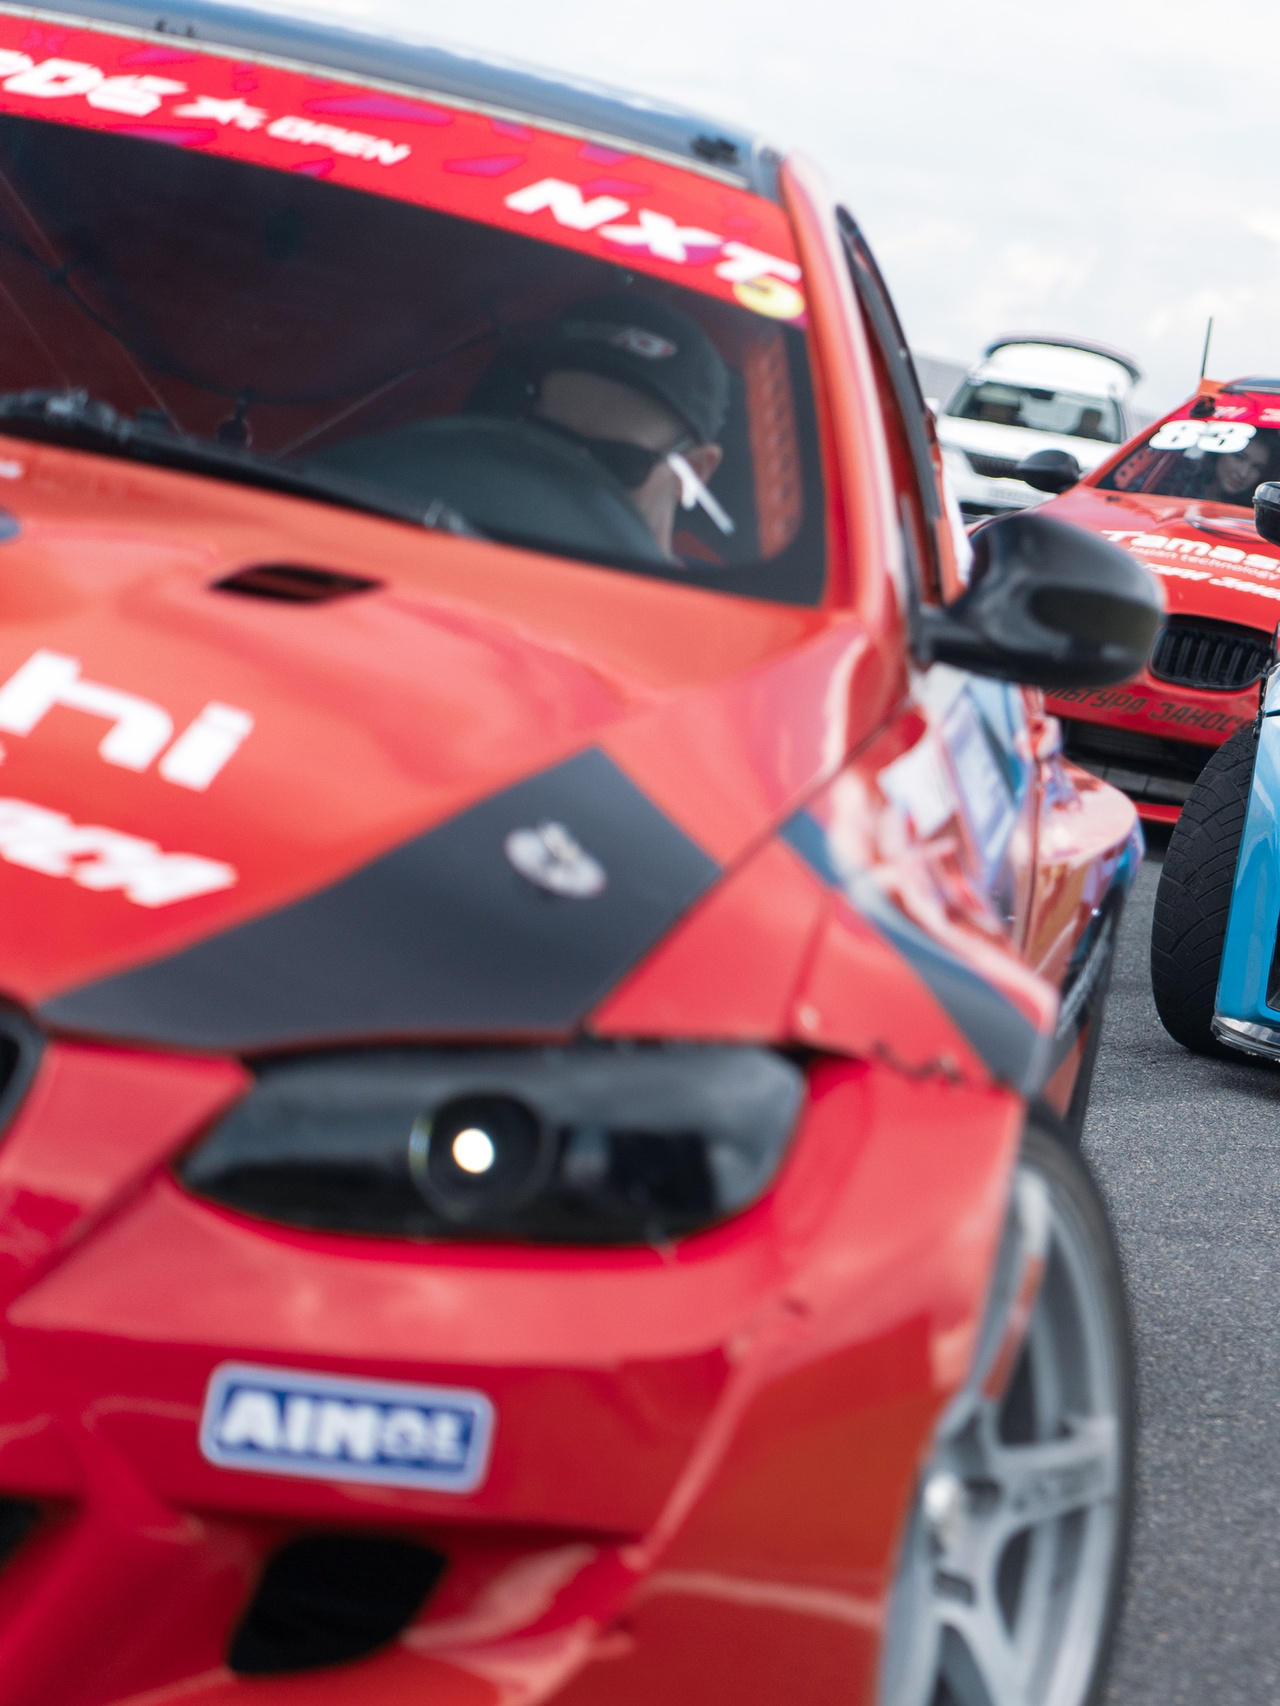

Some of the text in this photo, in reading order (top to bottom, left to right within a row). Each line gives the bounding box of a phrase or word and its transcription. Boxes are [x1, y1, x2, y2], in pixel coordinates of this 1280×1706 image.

[267, 116, 411, 166] OPEN
[503, 177, 801, 282] NXT
[1149, 420, 1257, 453] 83
[1181, 554, 1280, 581] technology
[222, 1391, 463, 1463] AIMOL
